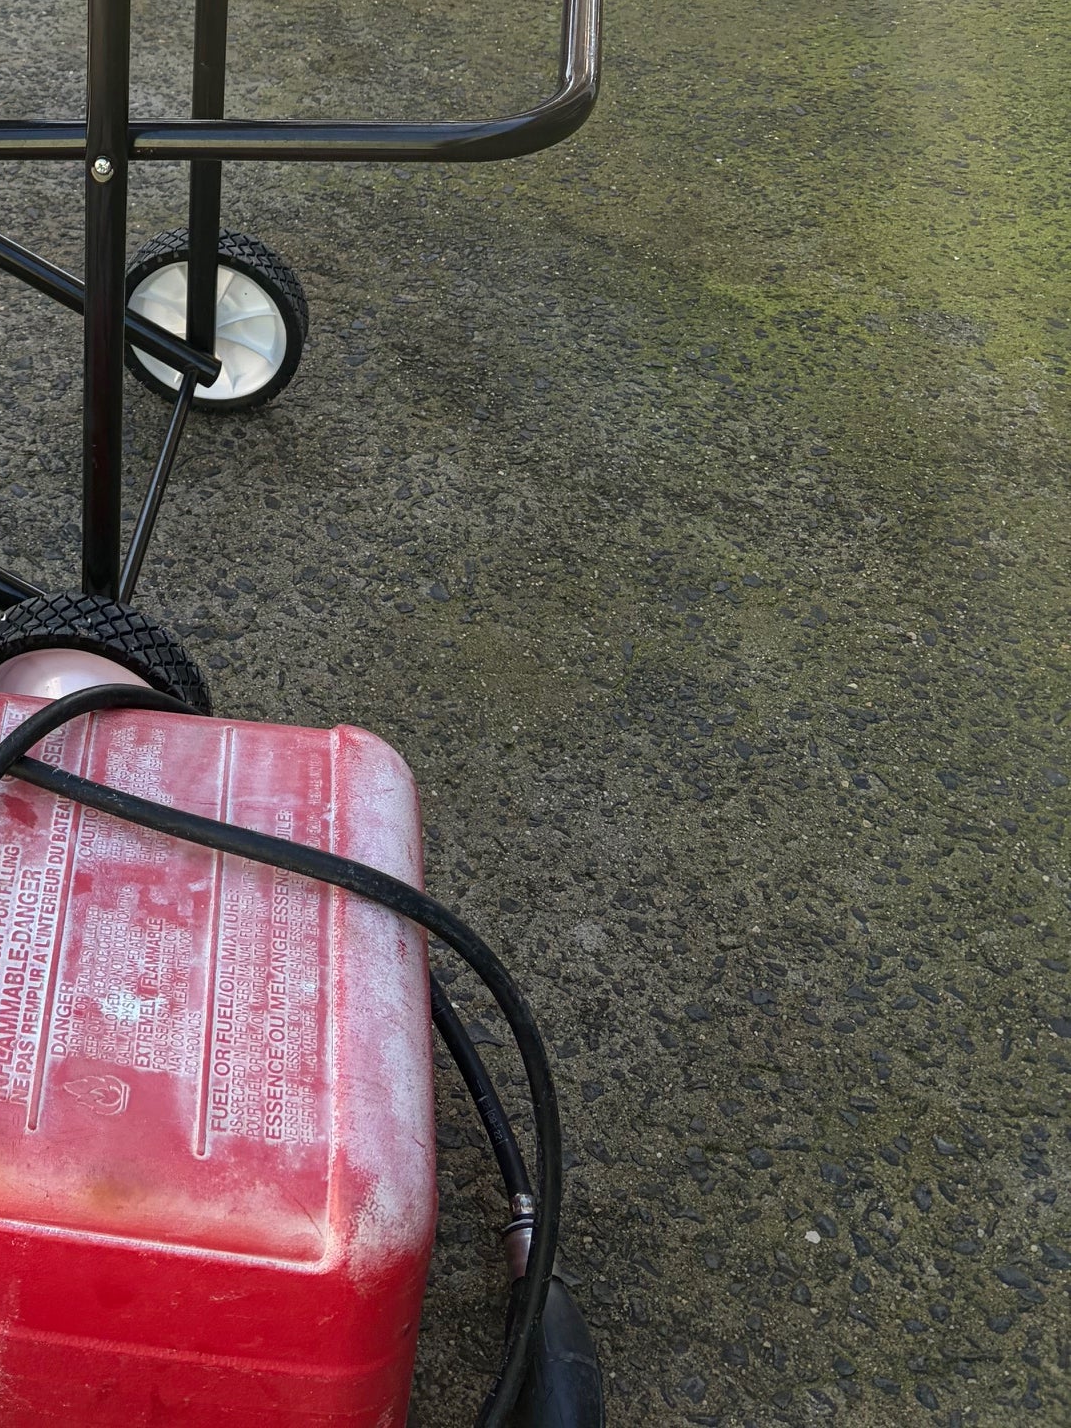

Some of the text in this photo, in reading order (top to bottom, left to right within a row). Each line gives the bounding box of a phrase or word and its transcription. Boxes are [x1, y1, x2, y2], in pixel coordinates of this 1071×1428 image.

[77, 807, 99, 858] CAUTIO
[47, 844, 65, 864] DU
[238, 894, 255, 938] FURNISHED
[110, 924, 128, 957] INDUCE
[161, 943, 176, 964] FUEL
[303, 938, 317, 962] DANS
[108, 956, 124, 976] NOT
[236, 941, 253, 976] MANUAL
[265, 929, 289, 1010] MÉLANGE
[76, 967, 91, 993] FATAL
[90, 965, 108, 994] REACH
[107, 977, 122, 991] DO
[132, 917, 164, 1068] EXTREMELY FLAMMABLE
[157, 966, 174, 999] MOTOR
[172, 981, 188, 1004] LEAD
[19, 968, 46, 1034] REMPLIR
[73, 995, 88, 1010] OR
[119, 979, 138, 1027] PHYSICIAN
[209, 888, 241, 1132] FUEL OR FUEL/OIL MIXTURE:
[288, 990, 301, 1004] DU
[48, 981, 76, 1056] DANGER
[99, 992, 121, 1052] SWALLOWED
[169, 1006, 186, 1047] CONTAIN
[245, 898, 268, 1136] POUR FUEL OR FUEL/OIL MIXTURE INTO THE TANK
[267, 1014, 285, 1042] OU
[287, 1007, 301, 1022] OU
[153, 1026, 169, 1047] USE
[182, 1010, 203, 1074] COMPOUNDS
[233, 1026, 248, 1045] THE
[14, 1039, 36, 1074] PAS
[115, 1039, 132, 1065] CALL
[151, 1049, 167, 1070] FOR
[167, 1050, 182, 1072] MAY
[9, 1079, 30, 1104] NE
[228, 1063, 247, 1116] SPECIFIED
[262, 1047, 286, 1140] ESSENCE
[285, 1082, 299, 1096] DE
[229, 1119, 243, 1134] AS
[283, 1099, 299, 1142] VERSER
